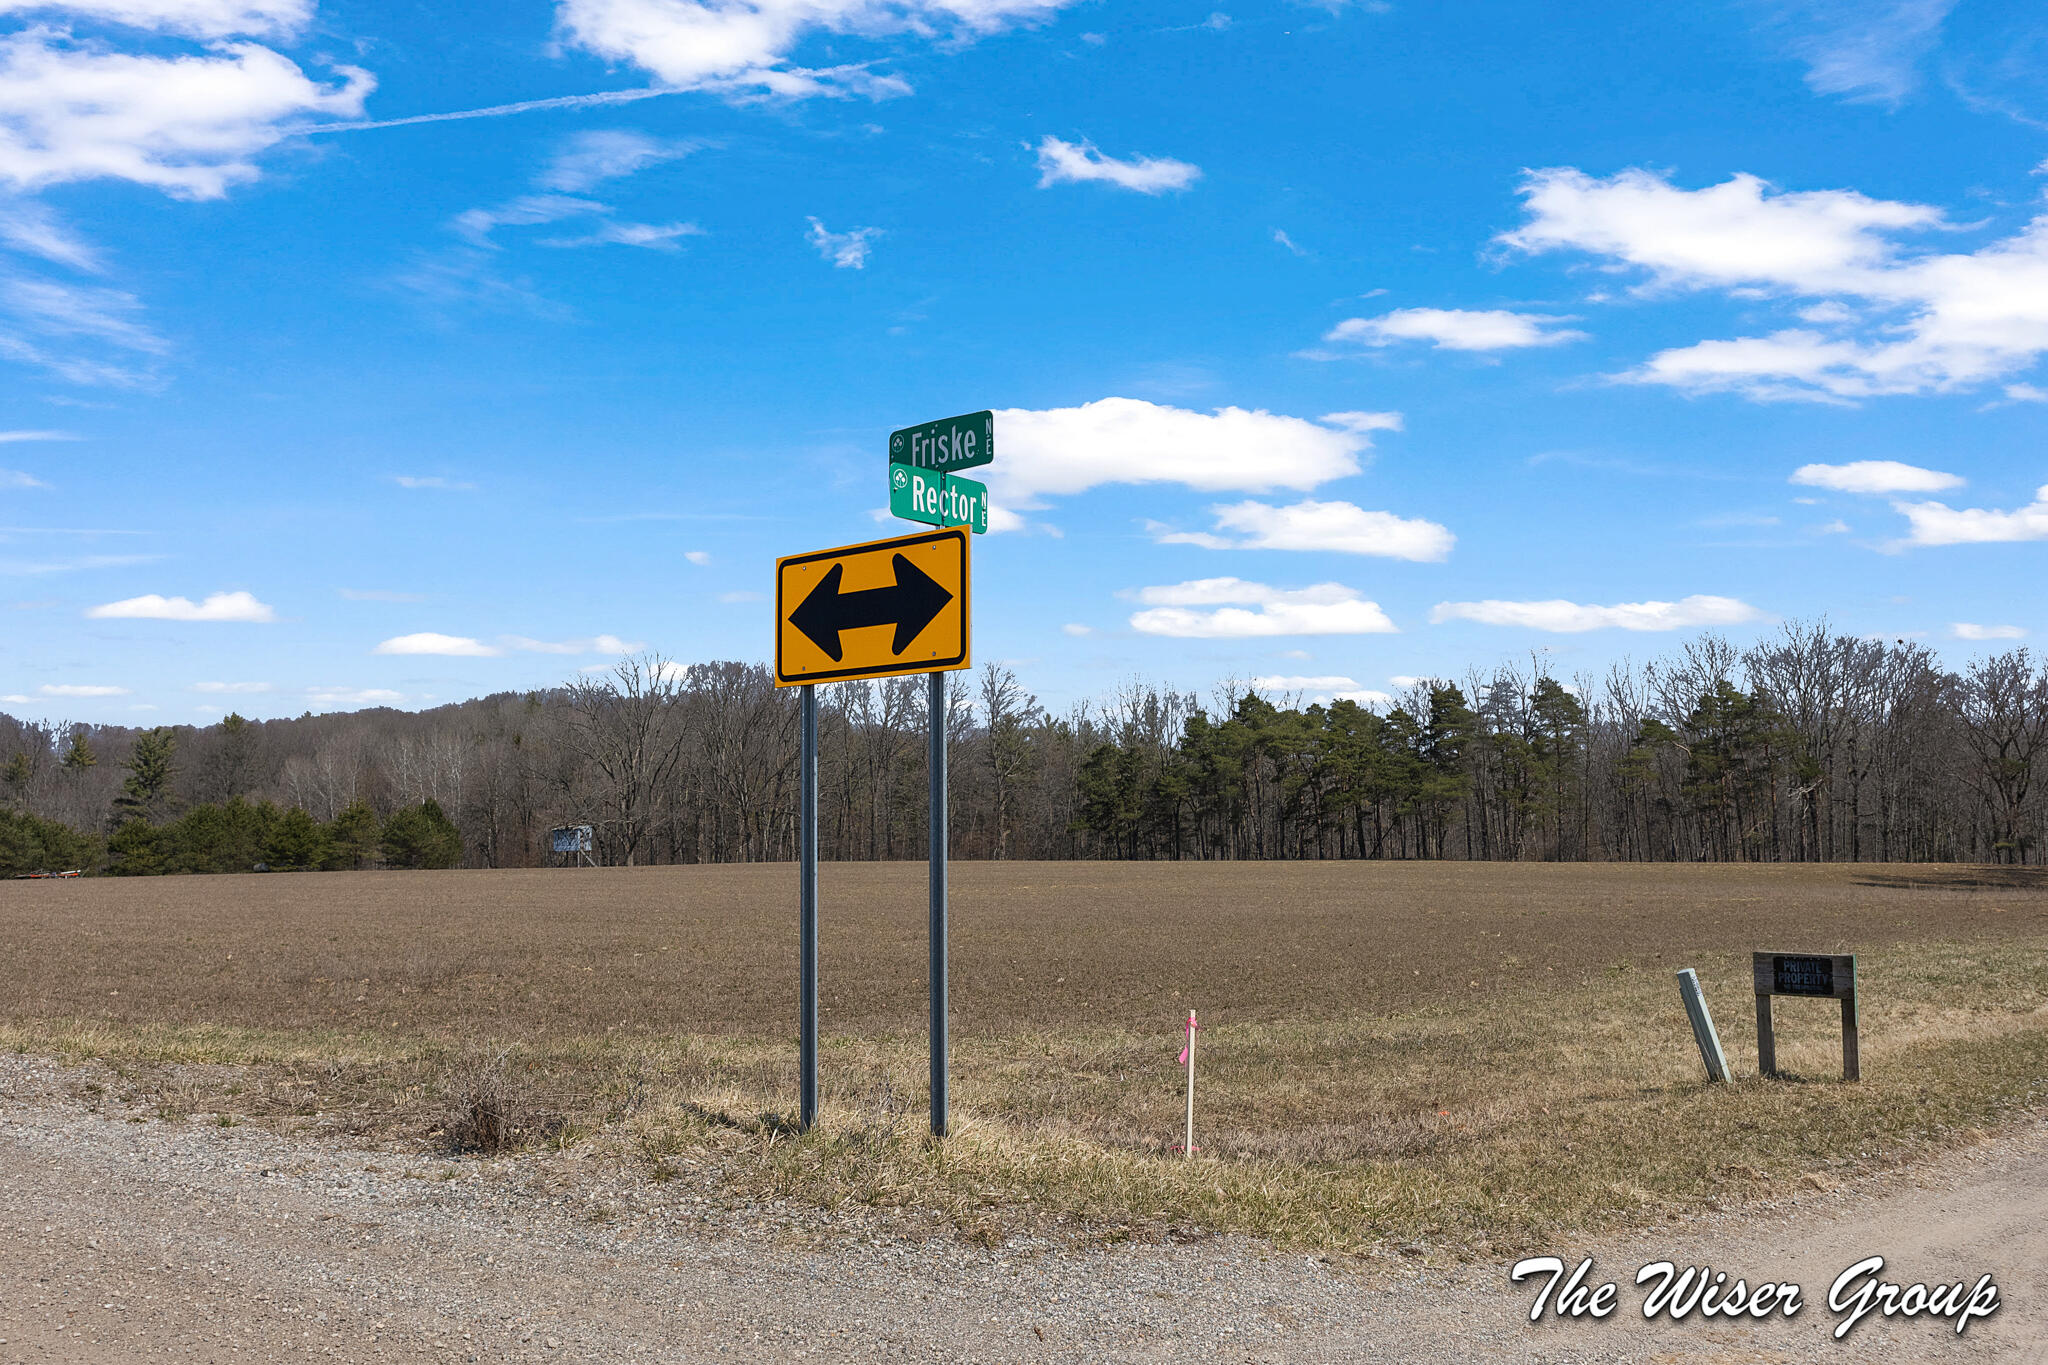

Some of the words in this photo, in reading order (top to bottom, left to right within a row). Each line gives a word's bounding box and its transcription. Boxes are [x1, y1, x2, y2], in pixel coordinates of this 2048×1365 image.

[912, 424, 977, 467] Friske
[912, 475, 977, 523] Rector
[1778, 972, 1828, 985] PROPERTY
[1783, 960, 1822, 973] PRIVATE
